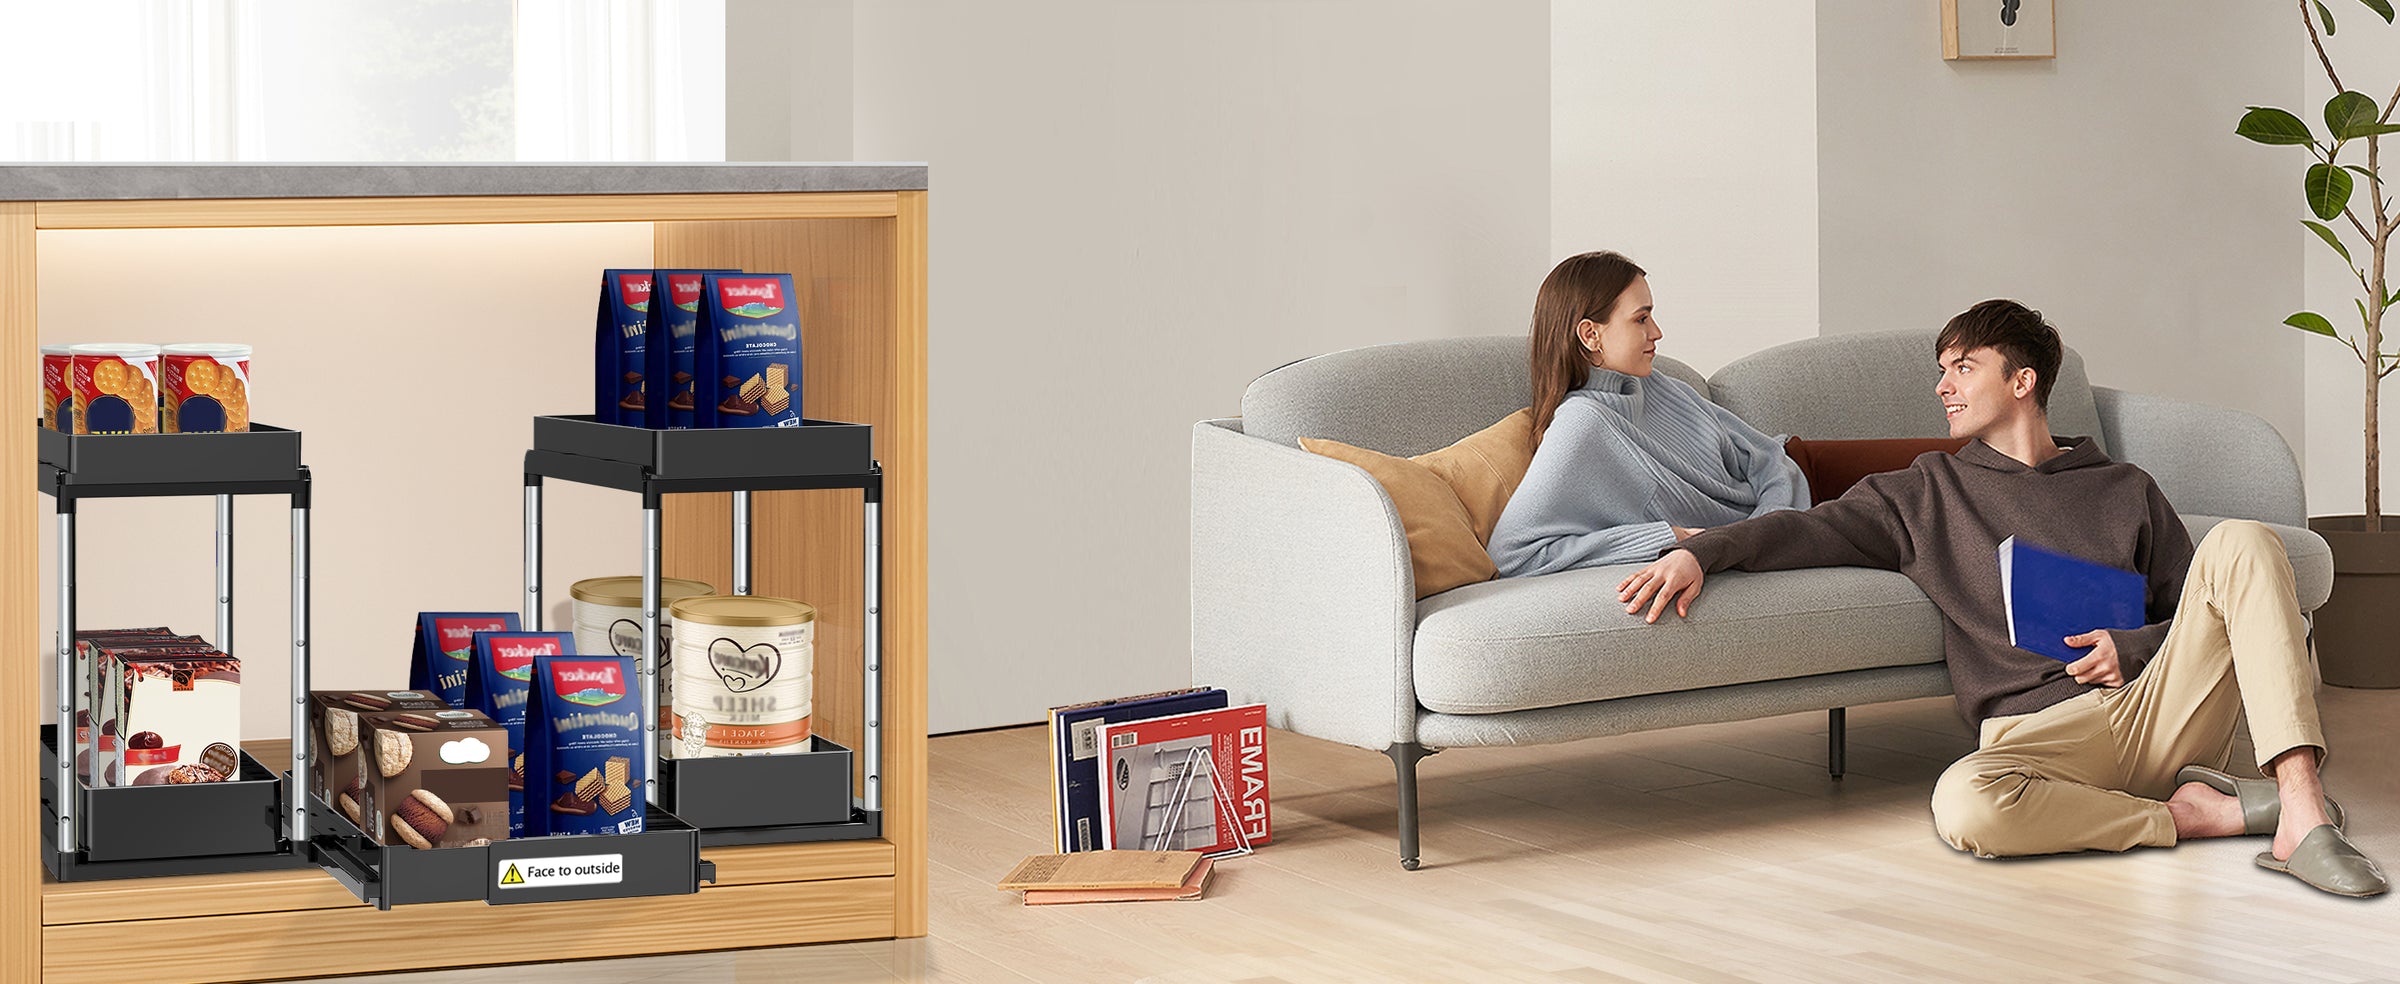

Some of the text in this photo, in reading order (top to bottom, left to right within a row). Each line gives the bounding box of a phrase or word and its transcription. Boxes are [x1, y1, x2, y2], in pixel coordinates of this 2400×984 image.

[528, 862, 620, 878] Face to outside
